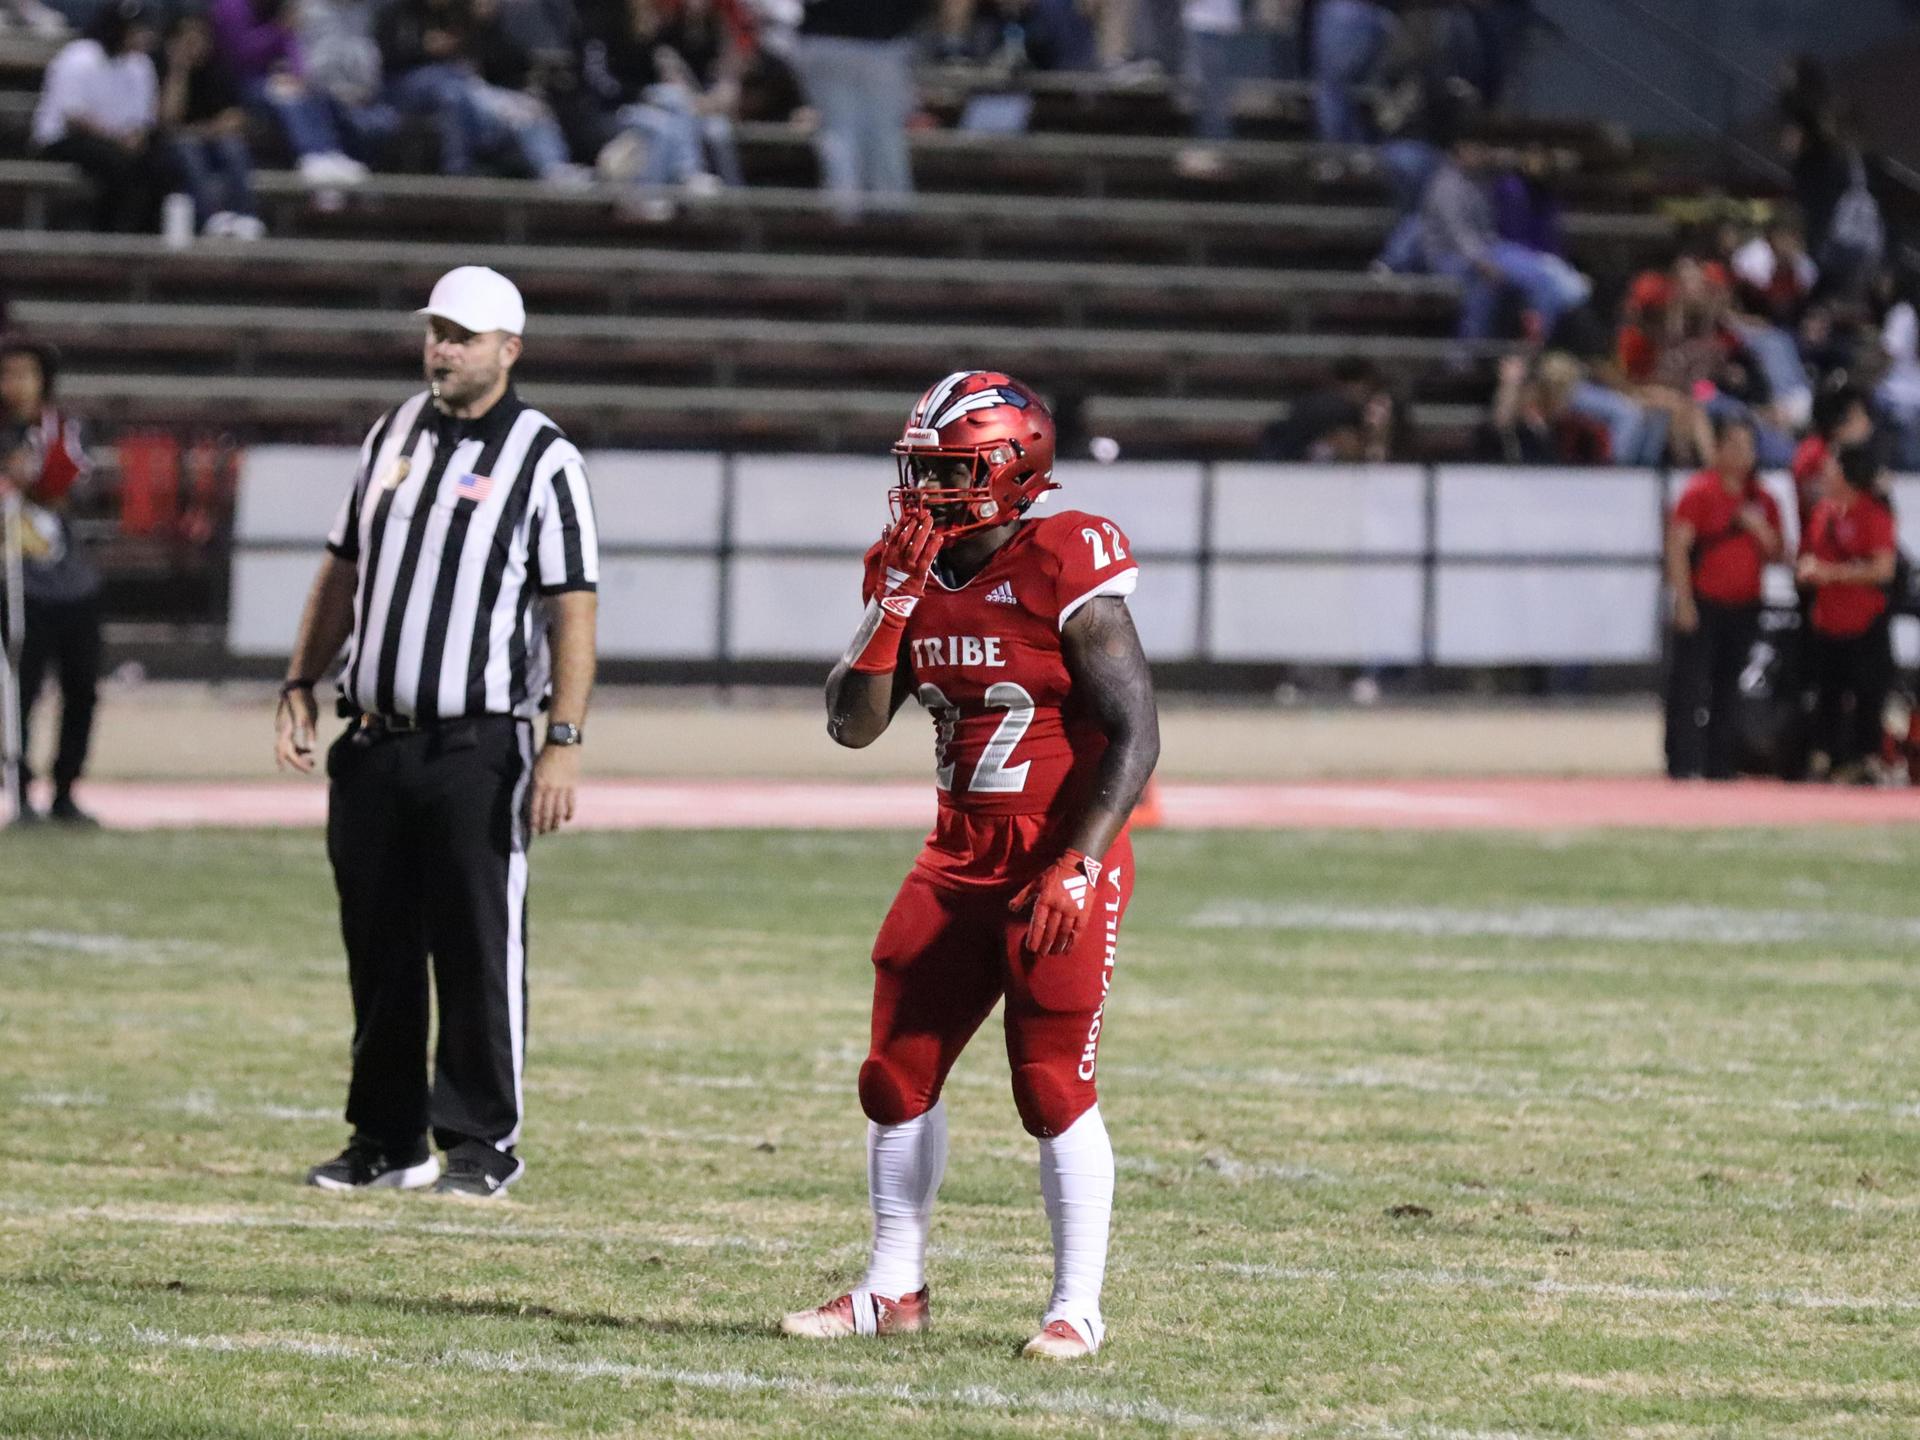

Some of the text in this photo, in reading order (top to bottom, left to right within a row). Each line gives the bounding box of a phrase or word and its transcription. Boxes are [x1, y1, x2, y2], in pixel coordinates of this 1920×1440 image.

[1081, 522, 1127, 570] 22
[985, 594, 1017, 605] adidas
[912, 636, 1006, 669] TRIBE
